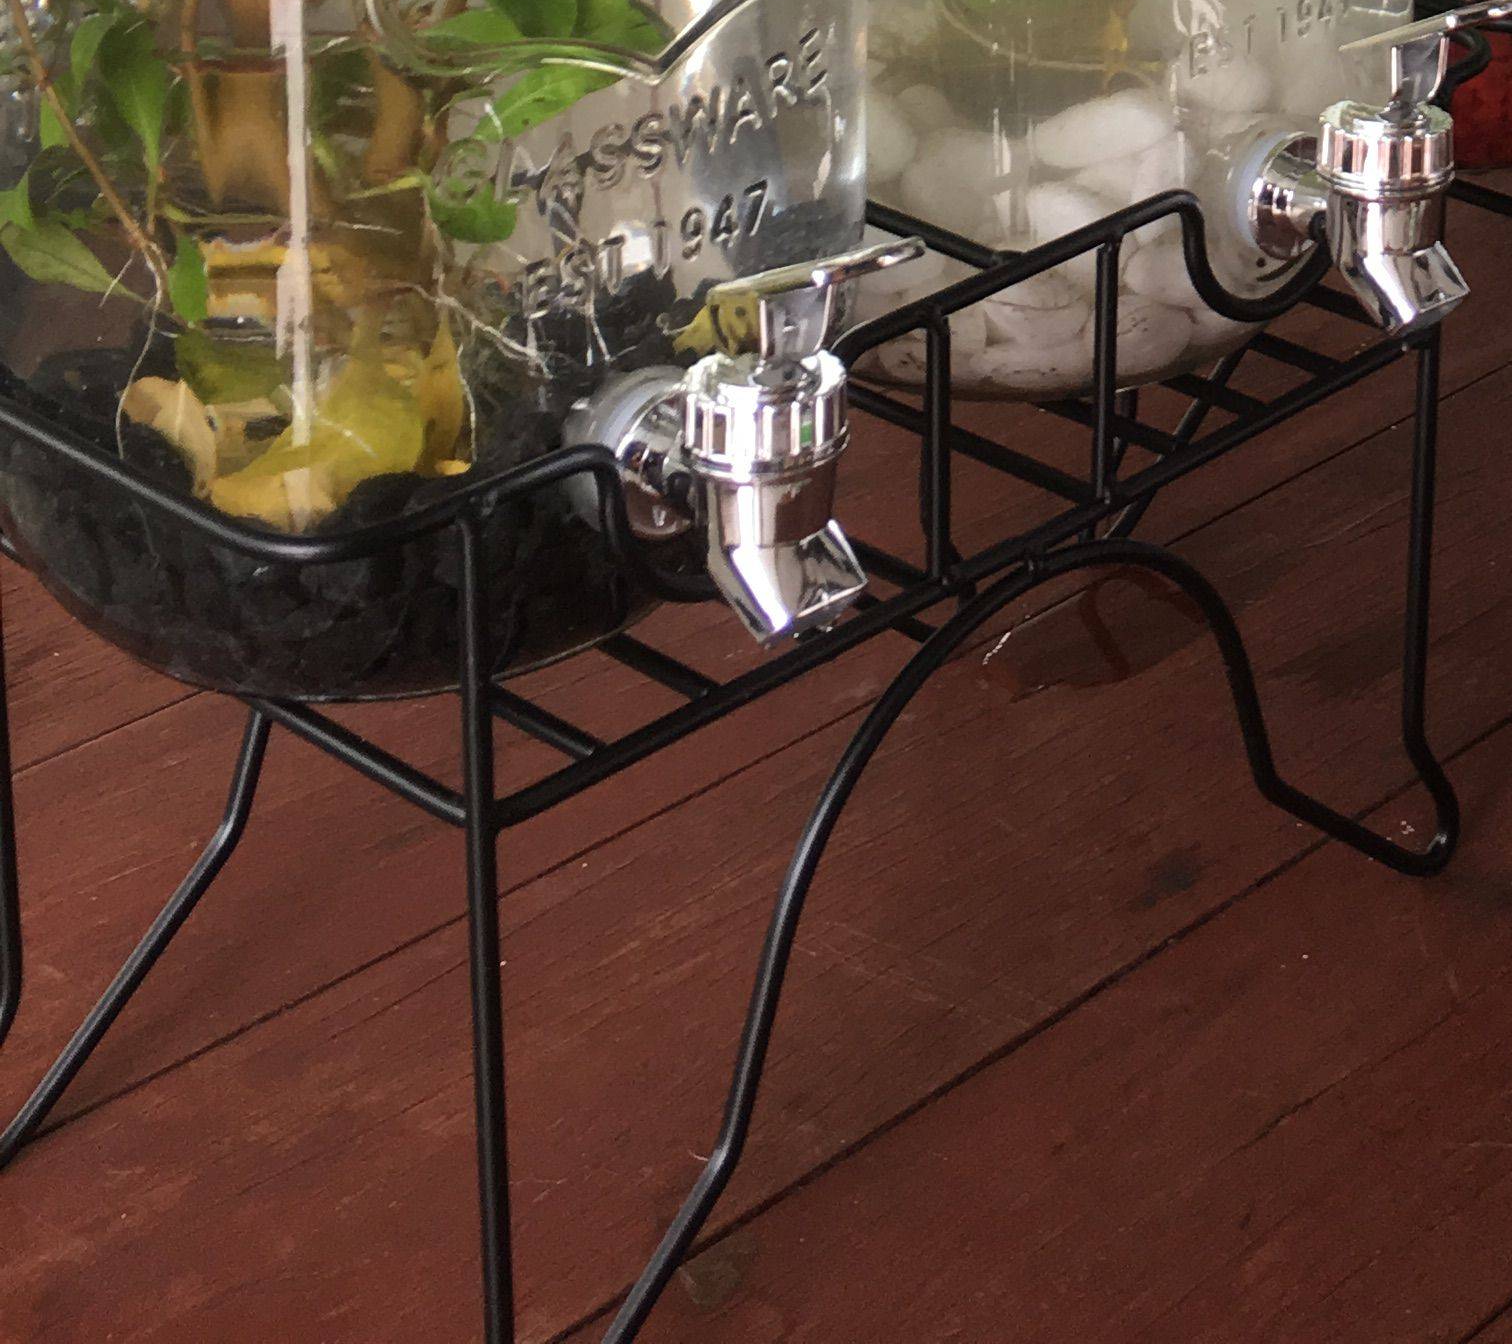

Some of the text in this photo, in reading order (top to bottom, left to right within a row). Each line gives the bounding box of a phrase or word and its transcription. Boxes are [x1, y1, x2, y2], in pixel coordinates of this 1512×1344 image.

[430, 24, 834, 216] GLASSWARE
[521, 178, 770, 319] EST 1947
